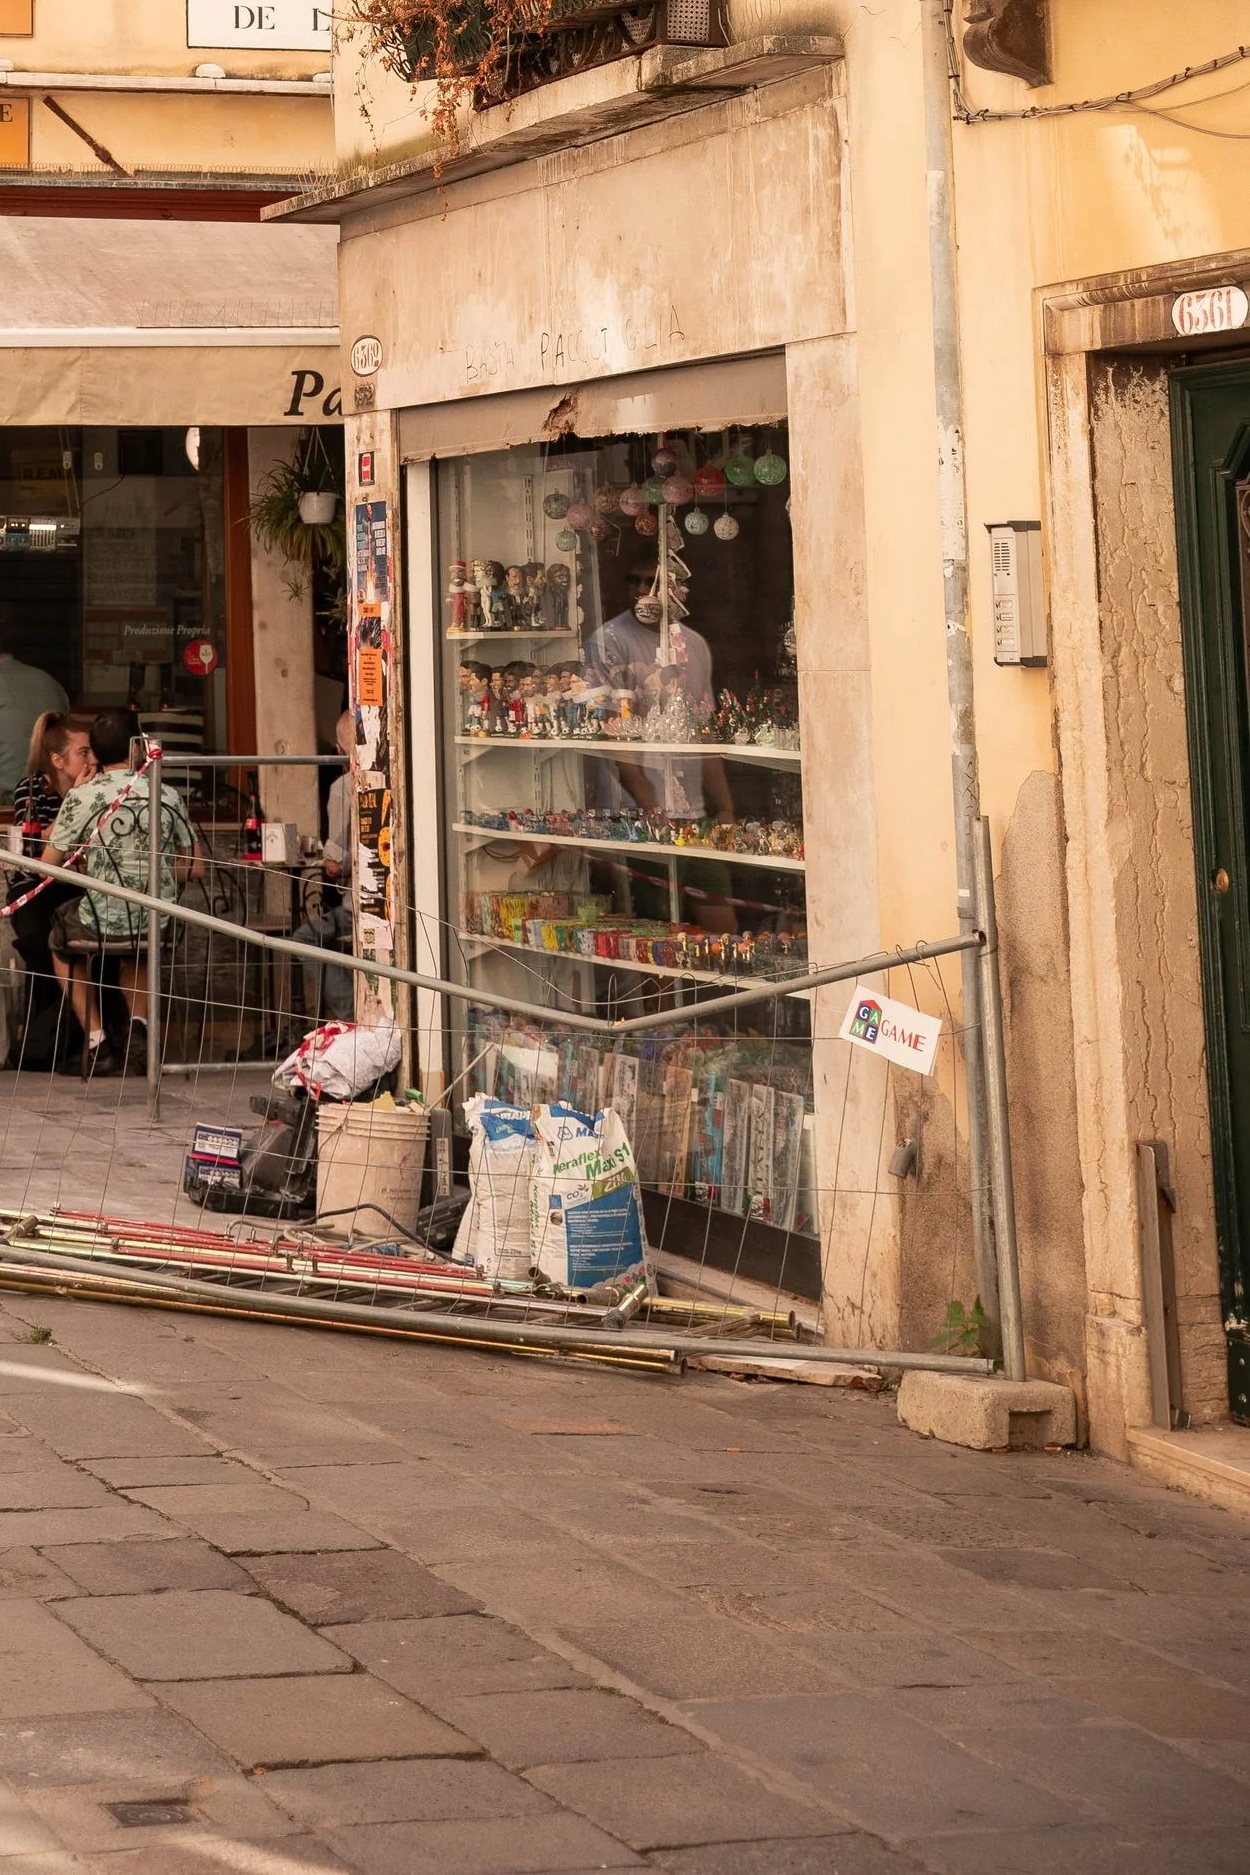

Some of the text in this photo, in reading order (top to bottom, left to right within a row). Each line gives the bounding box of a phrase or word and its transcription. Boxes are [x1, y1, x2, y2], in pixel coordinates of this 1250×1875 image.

[234, 5, 276, 30] DE
[1179, 290, 1233, 334] 6361
[124, 624, 210, 637] Produzione Propria
[880, 1019, 927, 1053] GAME
[585, 1141, 630, 1180] Maxi S1
